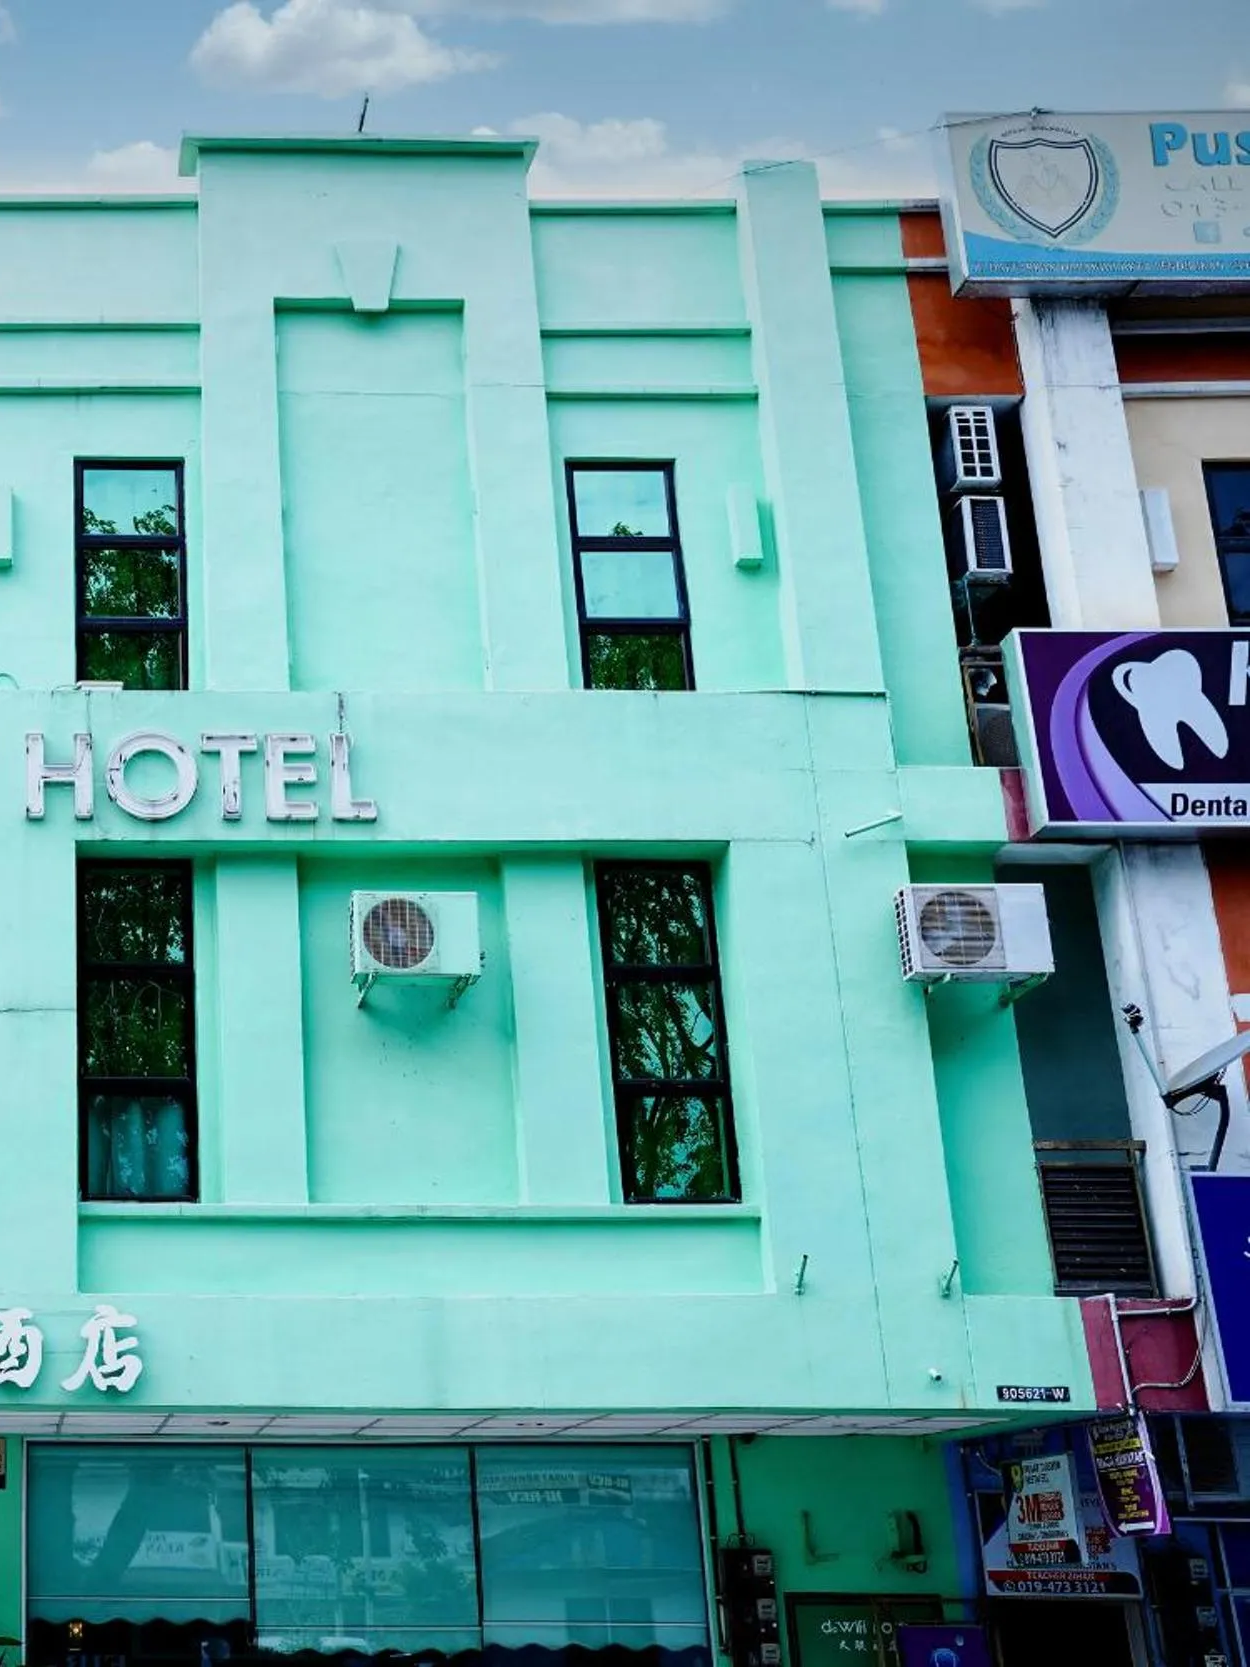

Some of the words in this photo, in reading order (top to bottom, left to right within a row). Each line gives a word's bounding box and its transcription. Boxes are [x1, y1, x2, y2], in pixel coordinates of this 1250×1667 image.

[25, 730, 379, 821] HOTEL
[1171, 793, 1247, 817] Denta
[1002, 1388, 1064, 1400] 905621-W
[1018, 1581, 1071, 1593] 019-473
[1073, 1581, 1106, 1593] 3121
